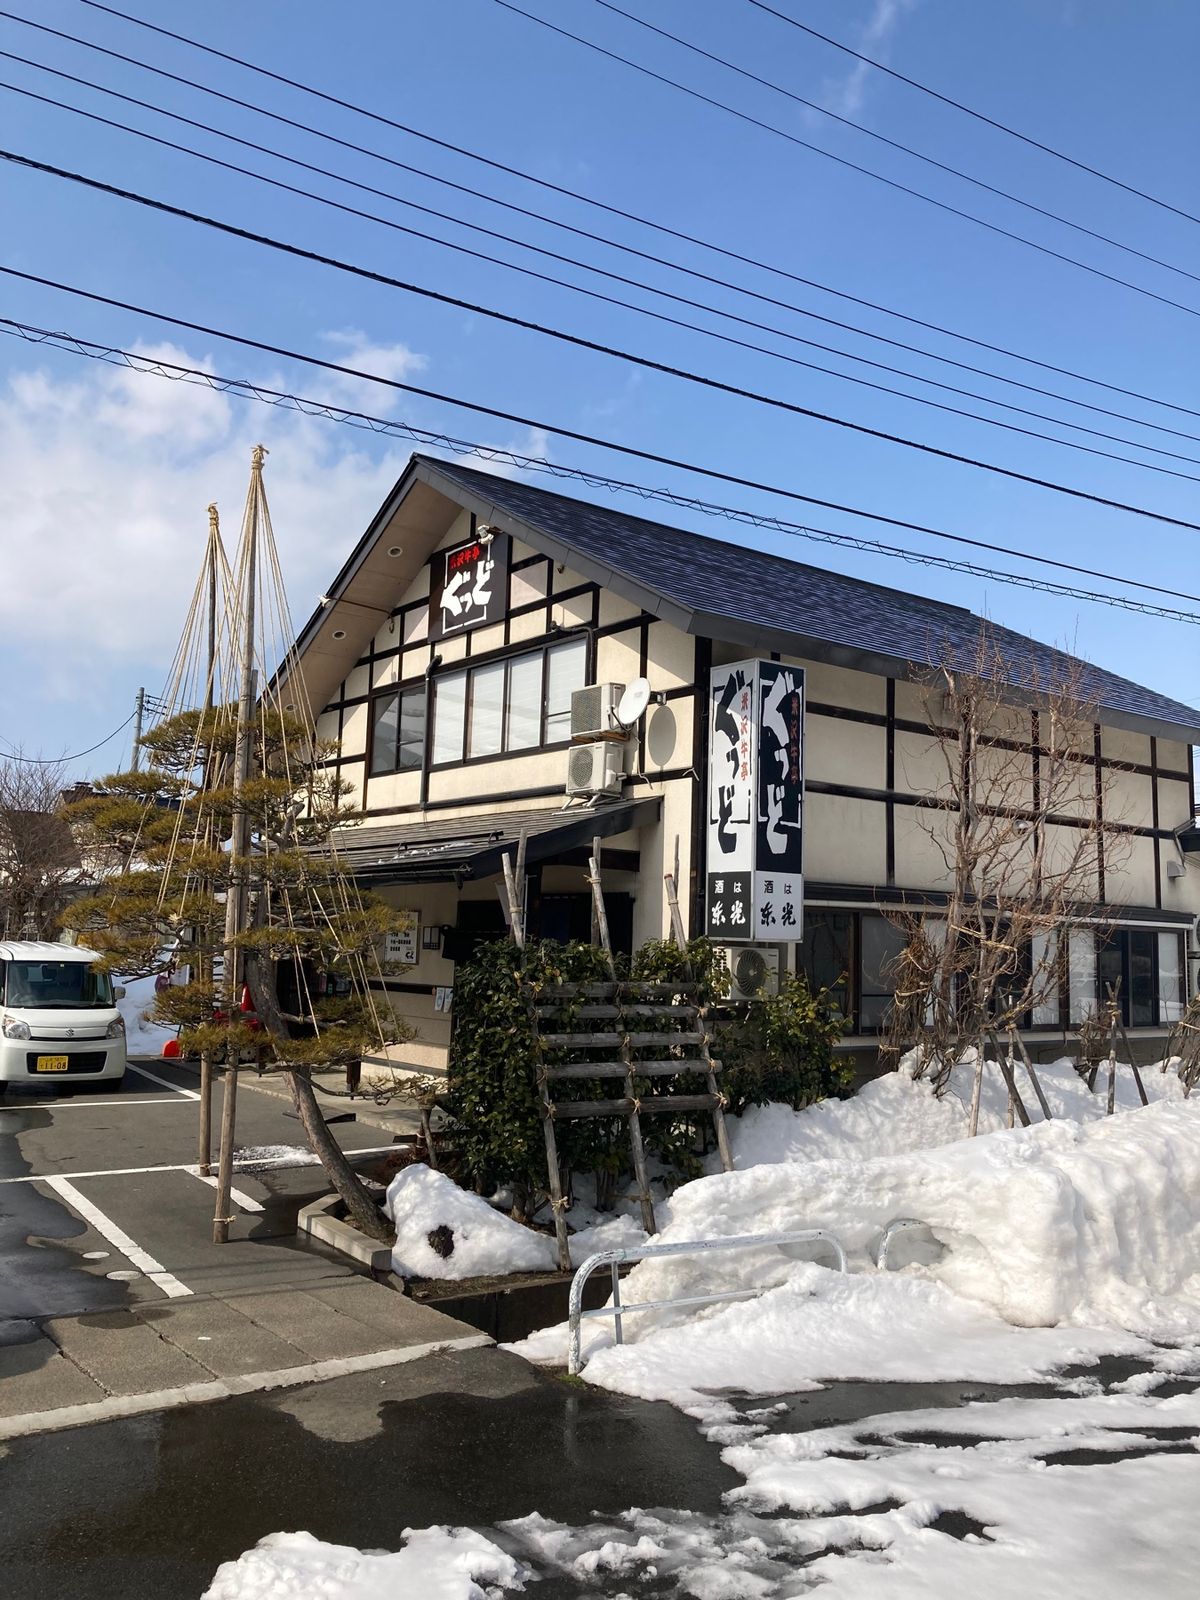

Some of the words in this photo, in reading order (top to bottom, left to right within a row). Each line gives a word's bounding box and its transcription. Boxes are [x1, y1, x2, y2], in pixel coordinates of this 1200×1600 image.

[440, 560, 494, 616] ぐっど
[715, 670, 745, 854] ぐっど
[762, 671, 795, 854] ぐっど
